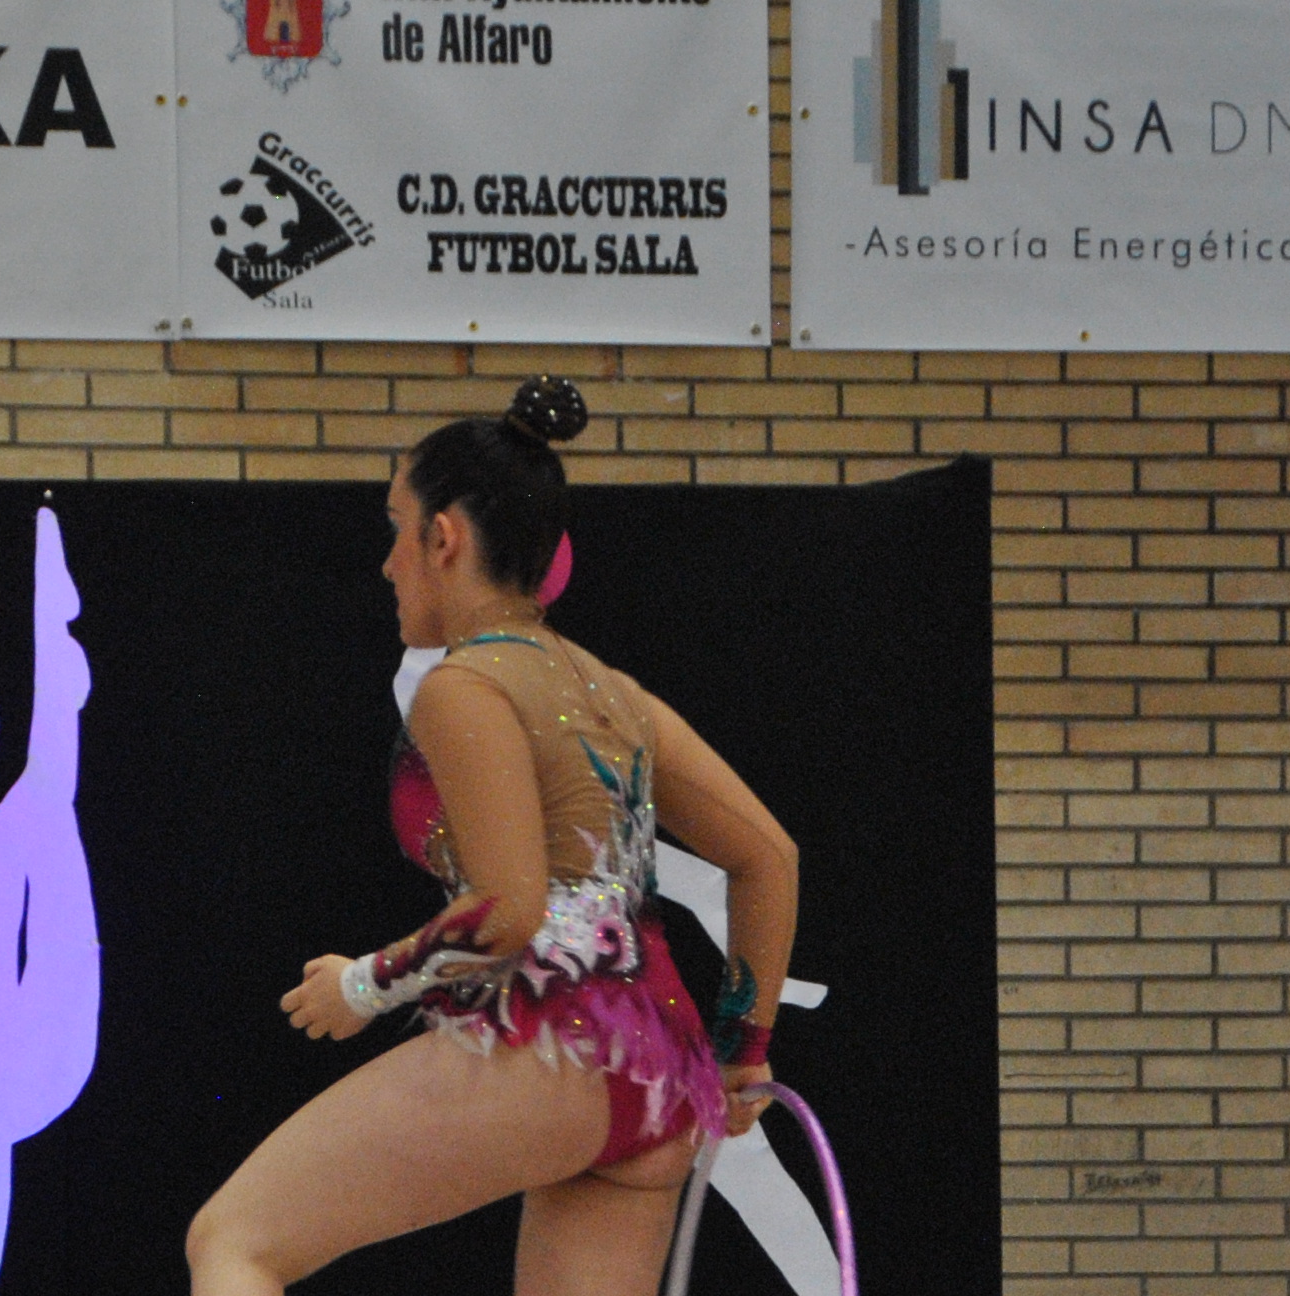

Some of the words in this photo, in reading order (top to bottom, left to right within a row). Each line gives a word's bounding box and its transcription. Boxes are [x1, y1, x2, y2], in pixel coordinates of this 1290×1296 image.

[382, 13, 425, 63] de
[438, 13, 553, 65] Alfaro
[987, 98, 1172, 154] INSA
[258, 131, 375, 247] Graccurris
[397, 174, 464, 215] C.D.
[474, 176, 728, 219] GRACCURRIS
[427, 231, 587, 274] FUTBOL
[595, 235, 699, 275] SALA
[262, 290, 313, 309] Sala
